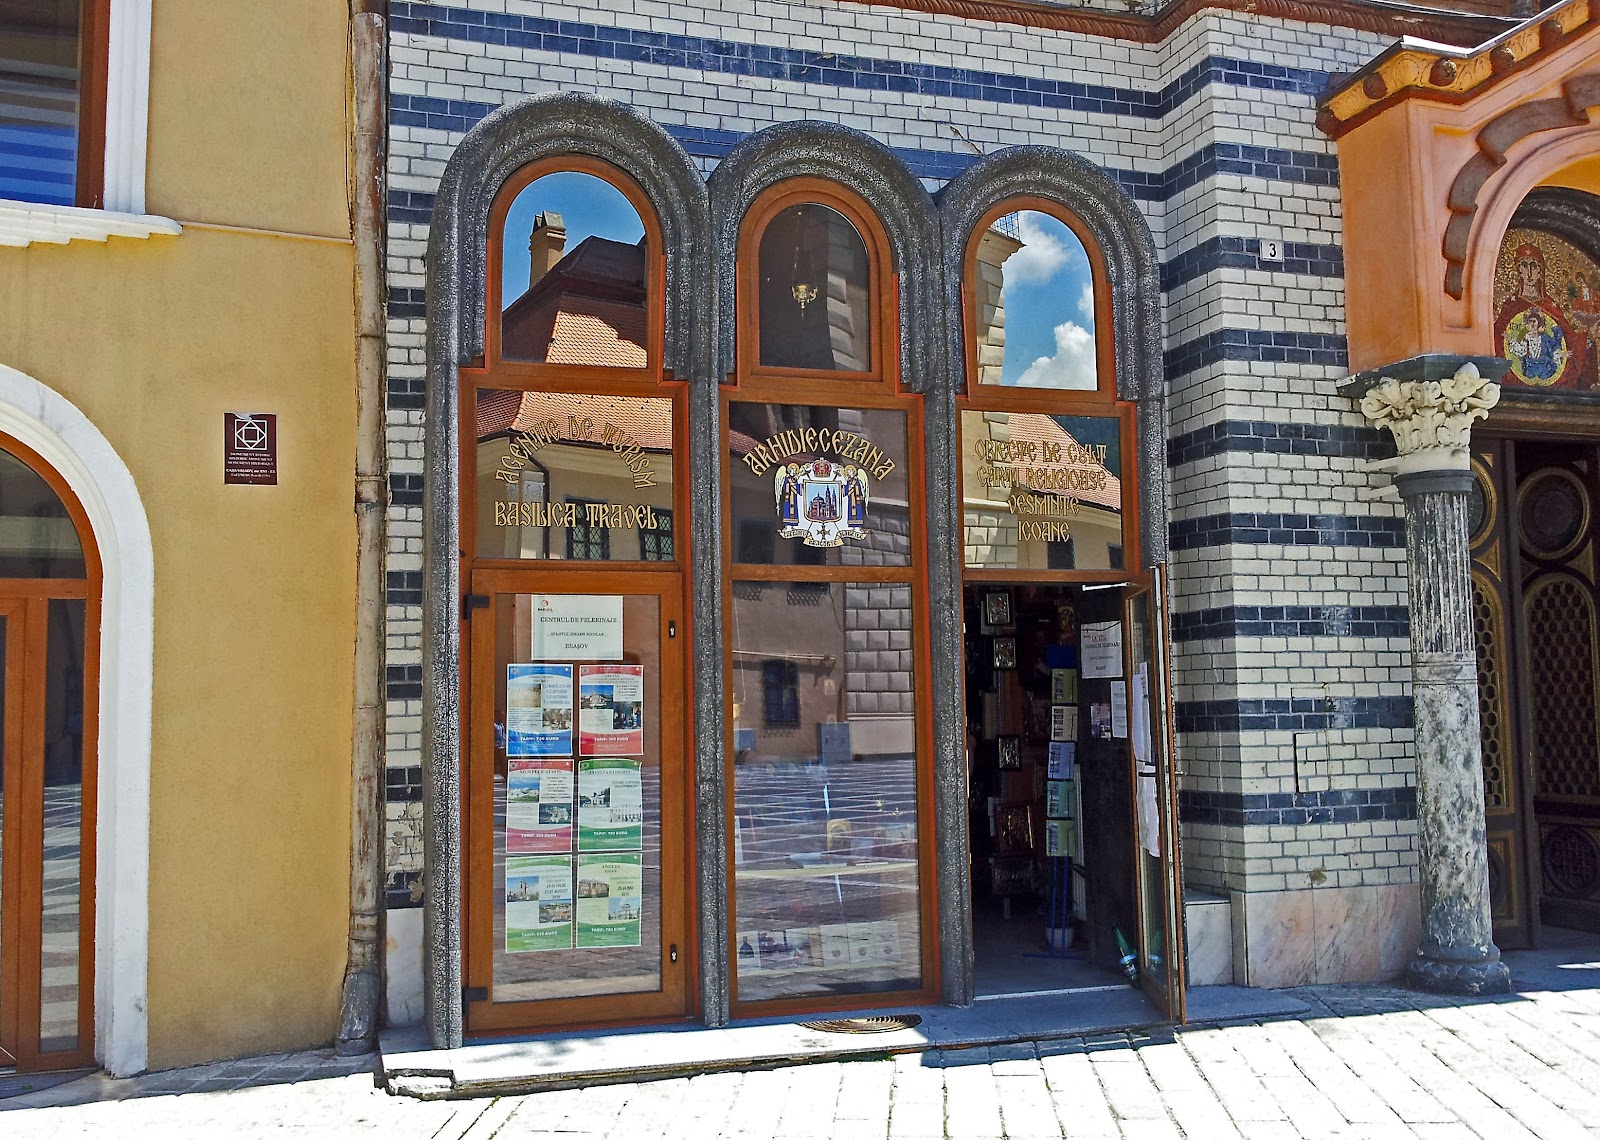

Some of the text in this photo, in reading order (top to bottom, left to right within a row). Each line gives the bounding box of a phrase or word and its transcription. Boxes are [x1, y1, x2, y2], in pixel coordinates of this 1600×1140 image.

[1270, 242, 1276, 258] 3
[567, 416, 593, 439] DE
[601, 422, 657, 489] TURISM
[742, 426, 896, 481] ARHIDIECEZANA
[1042, 440, 1062, 463] DE
[1068, 442, 1107, 464] CULT
[1025, 467, 1107, 491] RELIGIOASE
[494, 501, 658, 530] BASILICA TRAVEL
[1007, 494, 1080, 516] VESMINTE
[1018, 520, 1070, 543] ICOANE
